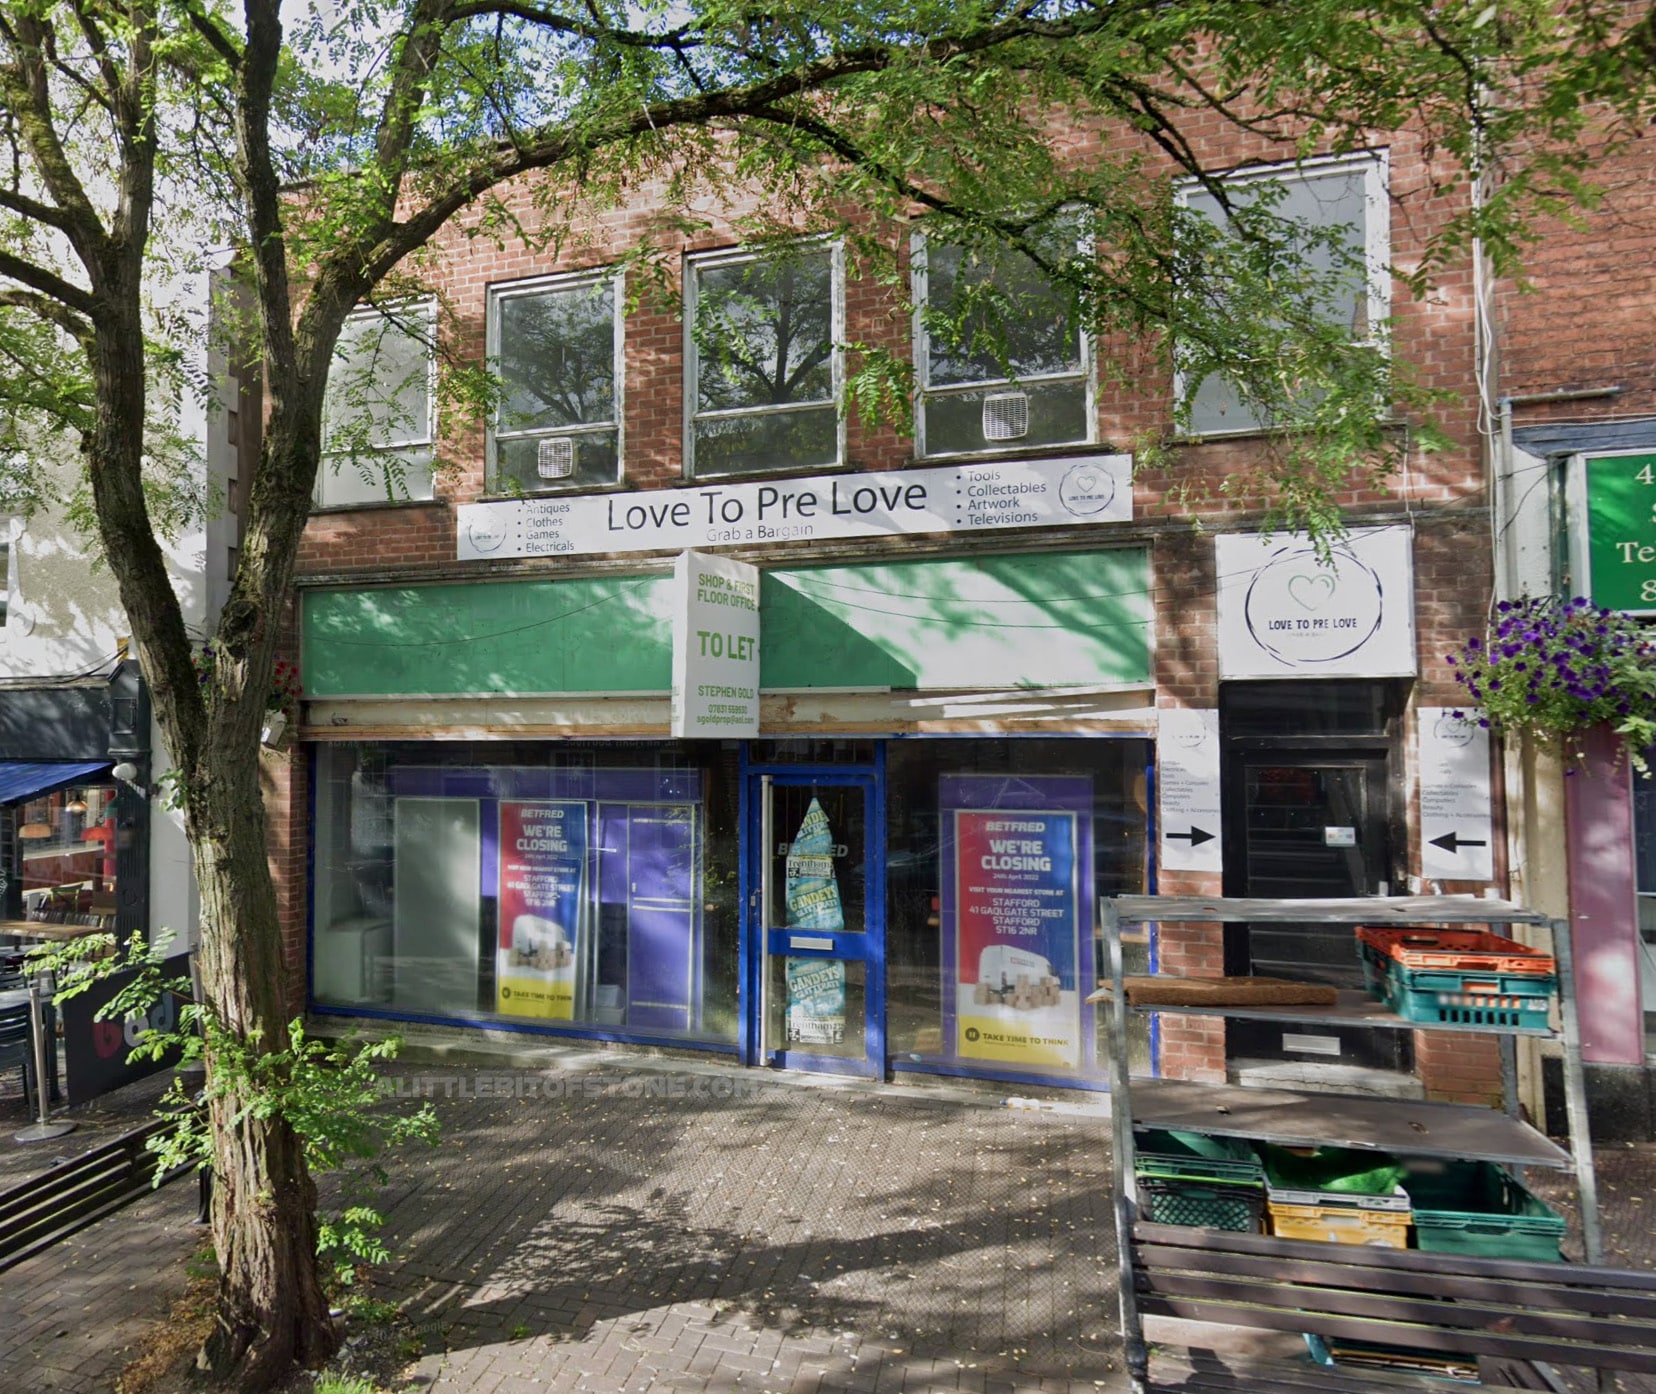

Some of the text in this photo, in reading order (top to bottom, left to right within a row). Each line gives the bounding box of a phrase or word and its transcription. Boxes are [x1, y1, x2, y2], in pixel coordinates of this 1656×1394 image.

[968, 471, 1000, 482] Tools
[968, 483, 1046, 497] Collectables
[526, 503, 570, 516] Antiques
[608, 481, 927, 531] Love To Pre Love
[968, 497, 1020, 510] Artwork
[526, 517, 563, 528] Clothes
[968, 512, 1038, 526] Televisions
[526, 530, 560, 540] Games
[706, 524, 814, 542] Grab a Bargain
[526, 541, 574, 553] Electricals
[1616, 541, 1656, 564] Te
[699, 573, 754, 596] SHOP & FIRST
[697, 589, 756, 611] FLOOR OFFICE
[1269, 618, 1358, 631] LOVE TO PRE LOVE
[697, 631, 755, 662] TO LET
[698, 685, 754, 699] STEPHEN GOLD
[521, 809, 564, 819] BETFRED
[523, 825, 562, 838] WE'RE
[985, 822, 1046, 832] BETFRED
[517, 839, 568, 852] CLOSING
[989, 840, 1043, 854] WE'RE
[981, 856, 1051, 872] CLOSING
[789, 886, 838, 912] GANDEYS
[992, 898, 1040, 908] STAFFORD
[969, 906, 979, 914] 41
[1030, 908, 1064, 918] STREET
[992, 916, 1040, 926] STAFFORD
[996, 925, 1038, 936] ST16 2NR
[789, 966, 840, 992] GANDEYS
[982, 1032, 1004, 1042] TAKE
[1006, 1035, 1028, 1044] TIME
[1030, 1037, 1041, 1045] TO
[1043, 1038, 1070, 1046] THINK
